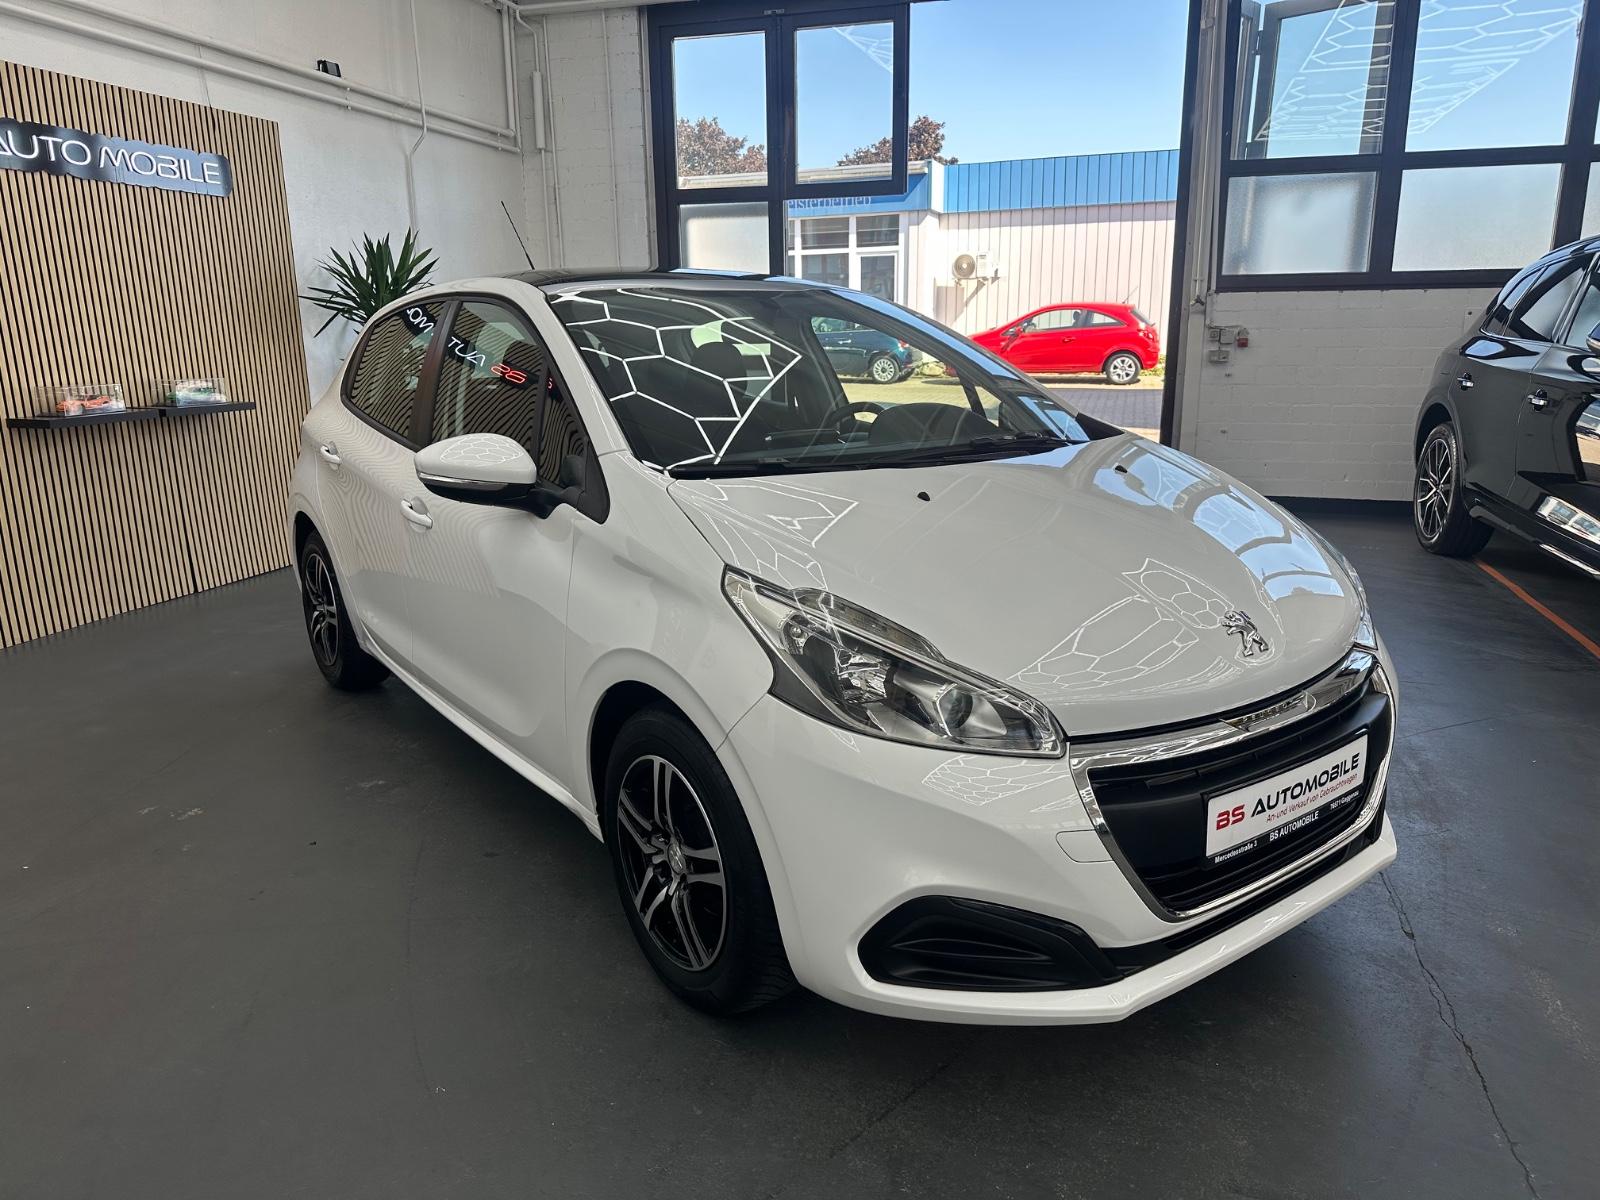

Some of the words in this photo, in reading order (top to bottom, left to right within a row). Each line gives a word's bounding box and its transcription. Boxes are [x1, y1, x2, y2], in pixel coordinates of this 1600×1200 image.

[100, 146, 221, 184] MOBILE
[787, 196, 872, 209] eisterbetrieb
[1216, 804, 1245, 830] BS
[1251, 752, 1360, 817] AUTOMOBILE
[1288, 797, 1310, 813] Verkauf
[1319, 773, 1358, 798] Gebrauchtwagen
[1269, 830, 1279, 842] BS
[1279, 811, 1319, 836] AUTOMOBILE
